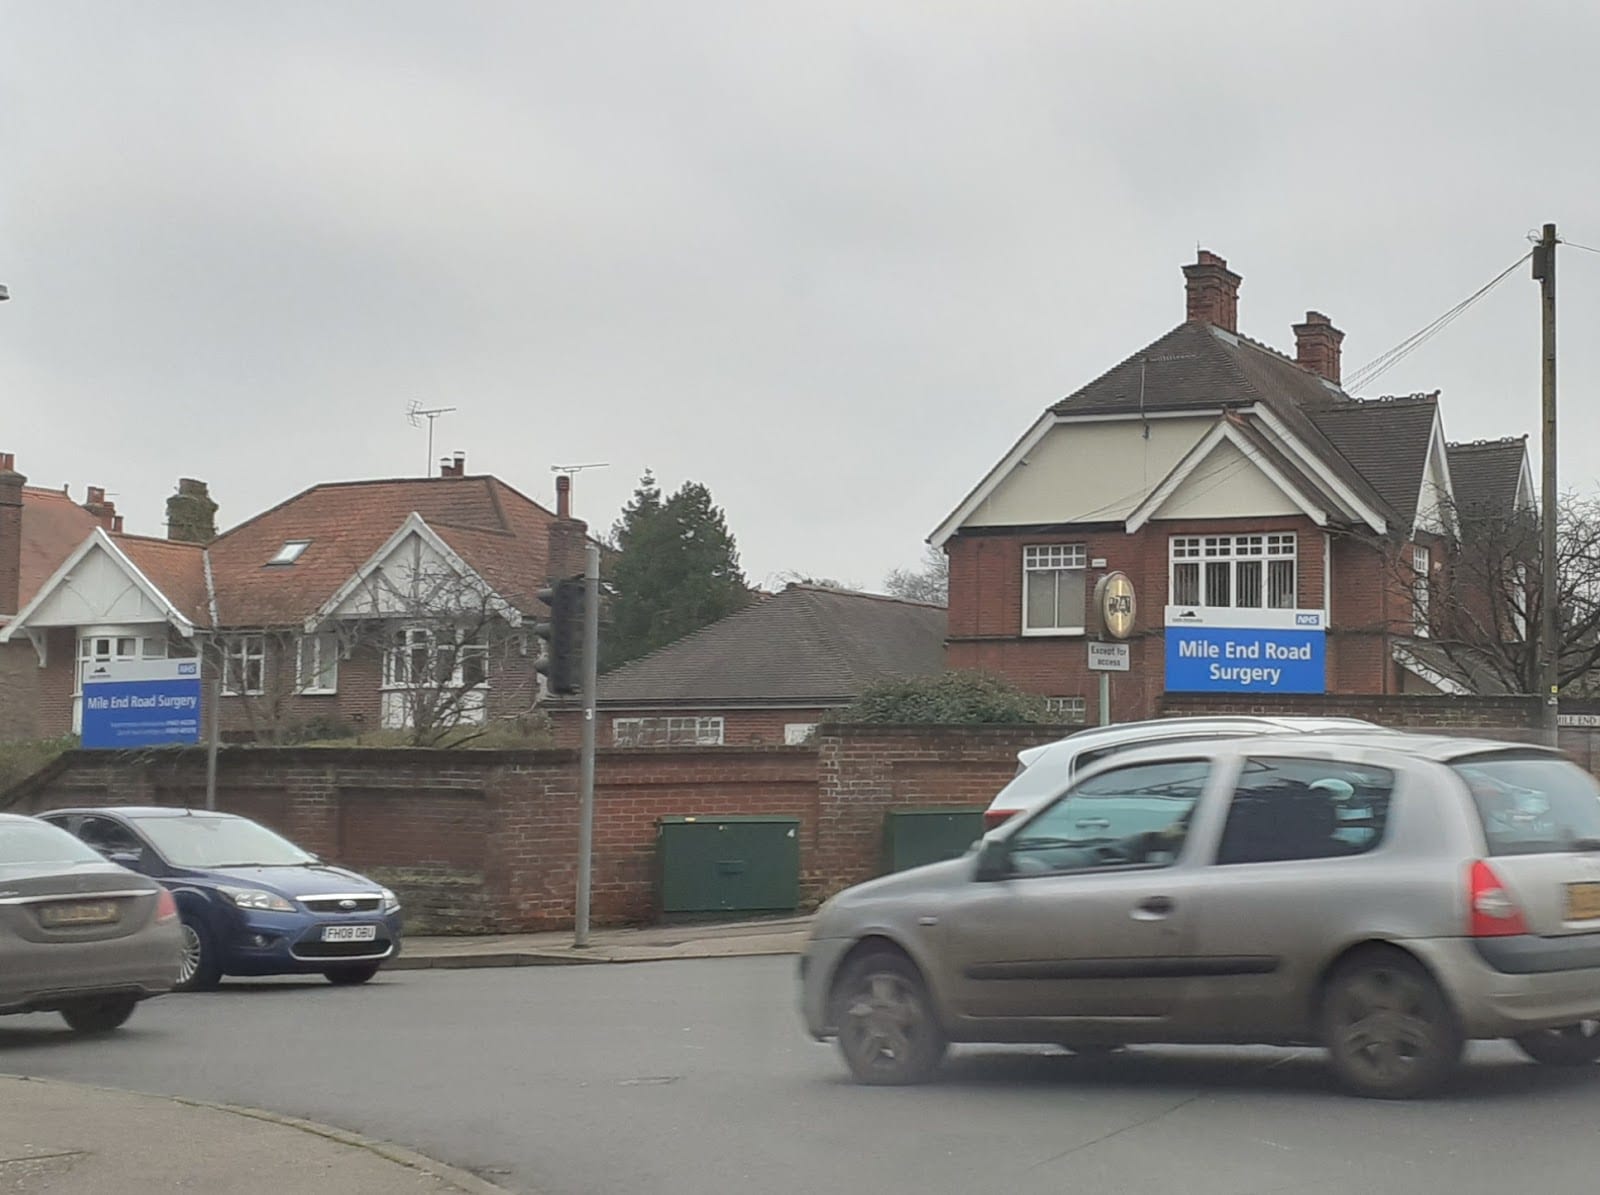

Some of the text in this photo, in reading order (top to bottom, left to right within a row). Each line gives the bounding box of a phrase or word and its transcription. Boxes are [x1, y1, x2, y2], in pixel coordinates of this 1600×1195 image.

[1297, 615, 1318, 624] NHS
[1091, 645, 1127, 657] Except for
[1178, 640, 1311, 660] Mile End Road
[1097, 658, 1121, 667] access
[180, 665, 195, 673] NHS
[1209, 663, 1281, 685] Surgery
[87, 694, 197, 710] Mile End Road Surgery
[585, 708, 593, 720] 3
[328, 927, 352, 939] FH08
